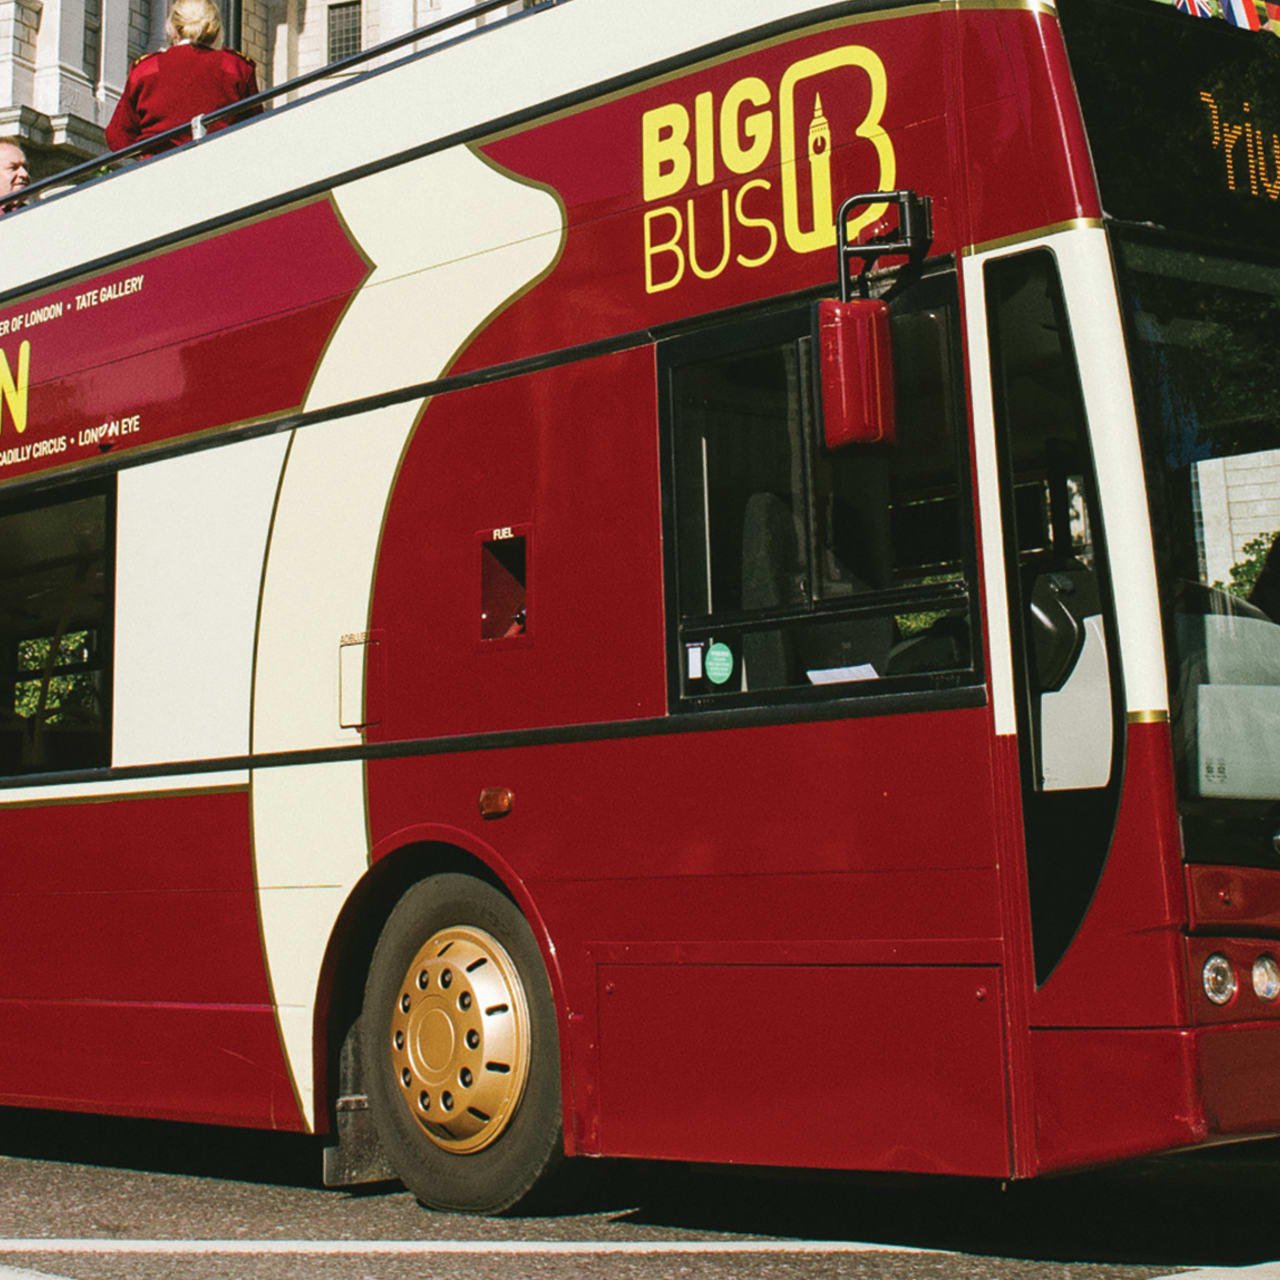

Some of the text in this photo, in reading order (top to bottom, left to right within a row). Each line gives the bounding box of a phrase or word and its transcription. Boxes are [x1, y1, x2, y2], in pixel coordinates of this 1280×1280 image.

[642, 76, 773, 202] BIG
[643, 178, 778, 294] BUS
[11, 315, 23, 332] OF
[24, 302, 63, 328] LONDON
[75, 289, 99, 310] TATE
[99, 275, 145, 302] GALLERY
[32, 436, 67, 459] CIRCUS
[78, 420, 119, 446] LONDN
[121, 415, 141, 435] EYE
[493, 527, 514, 541] FUEL
